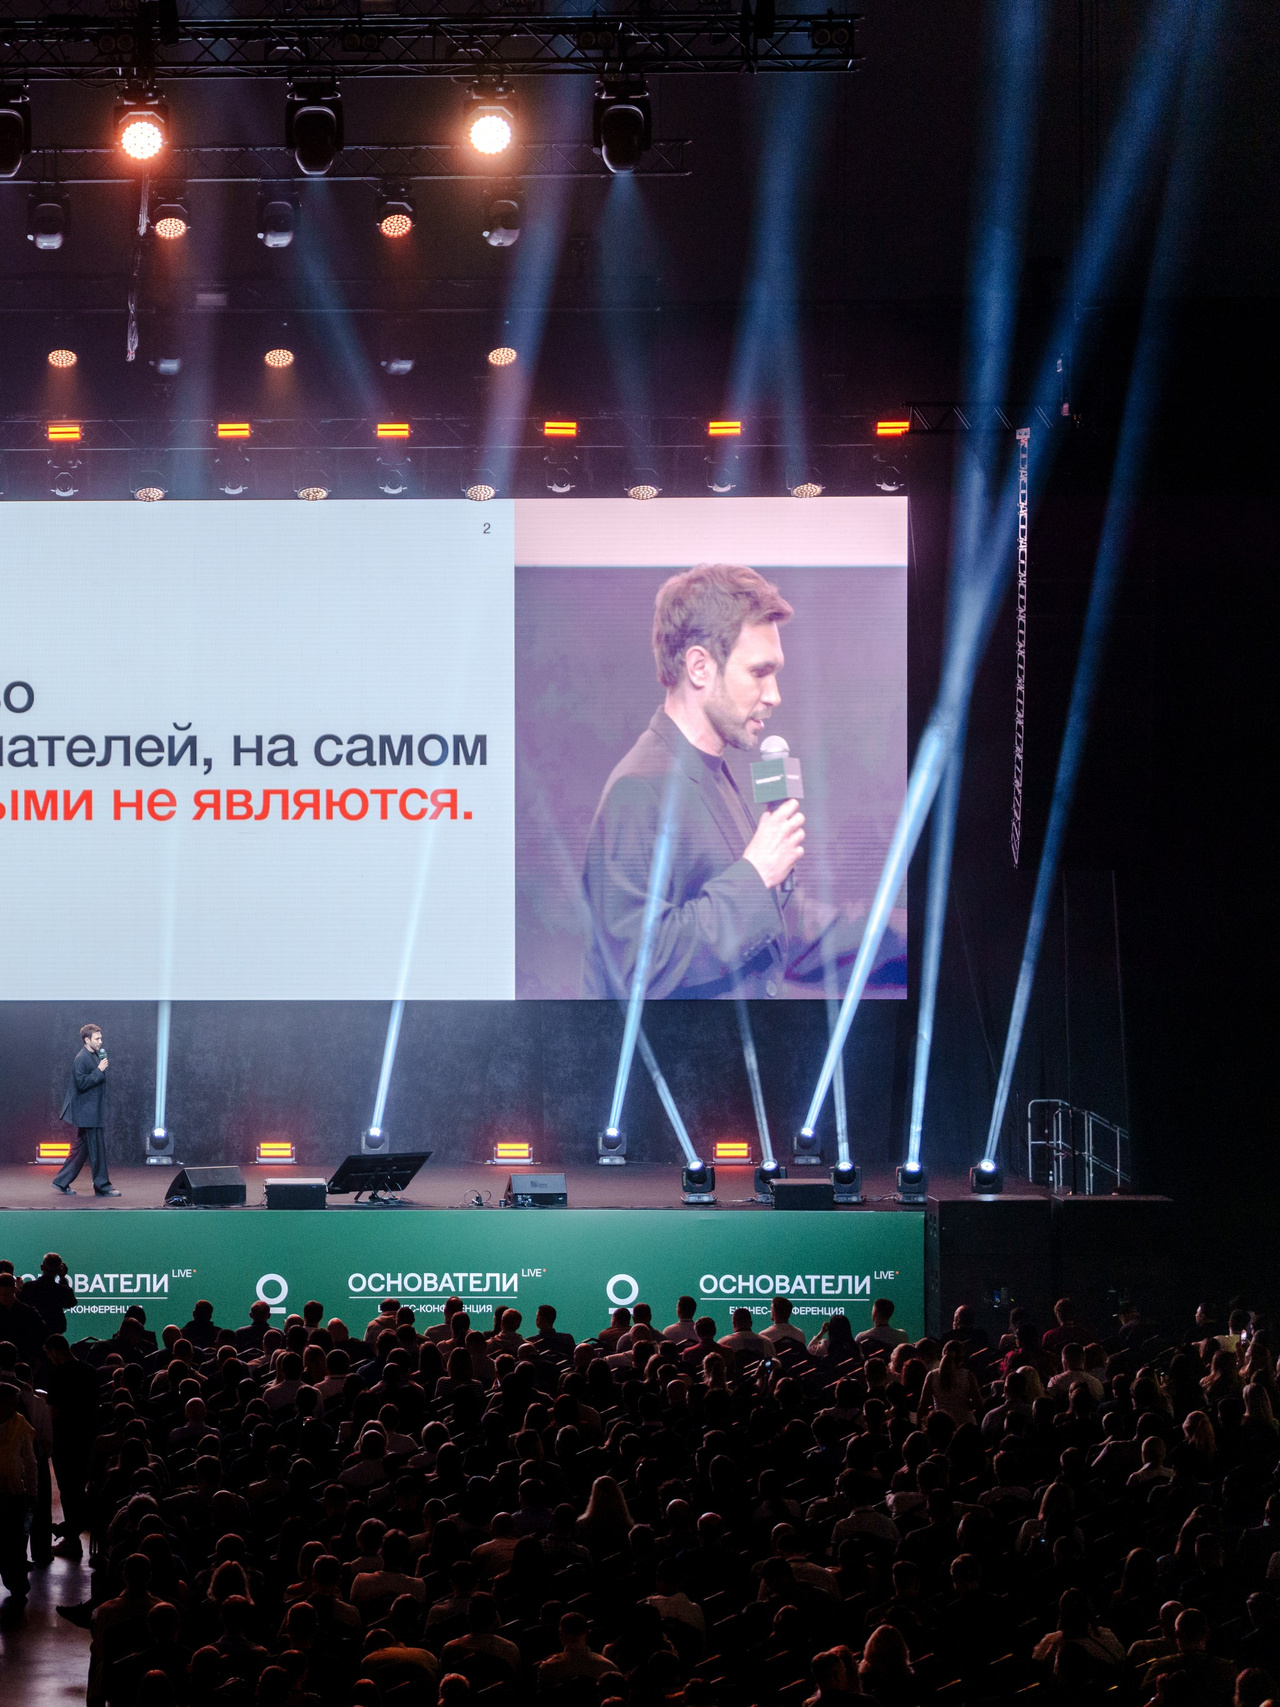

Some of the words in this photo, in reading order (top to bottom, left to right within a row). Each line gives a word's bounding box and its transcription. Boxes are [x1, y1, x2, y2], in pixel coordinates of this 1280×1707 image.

[482, 522, 491, 534] 2
[232, 733, 298, 768] на
[313, 733, 487, 768] самом
[113, 788, 177, 822] не
[191, 788, 473, 822] являются.
[171, 1269, 192, 1278] LIVE
[348, 1272, 518, 1293] ОСНОВАТЕЛИ
[521, 1268, 542, 1277] LIVE
[699, 1274, 871, 1294] ОСНОВАТЕЛИ
[874, 1271, 895, 1280] LIVE
